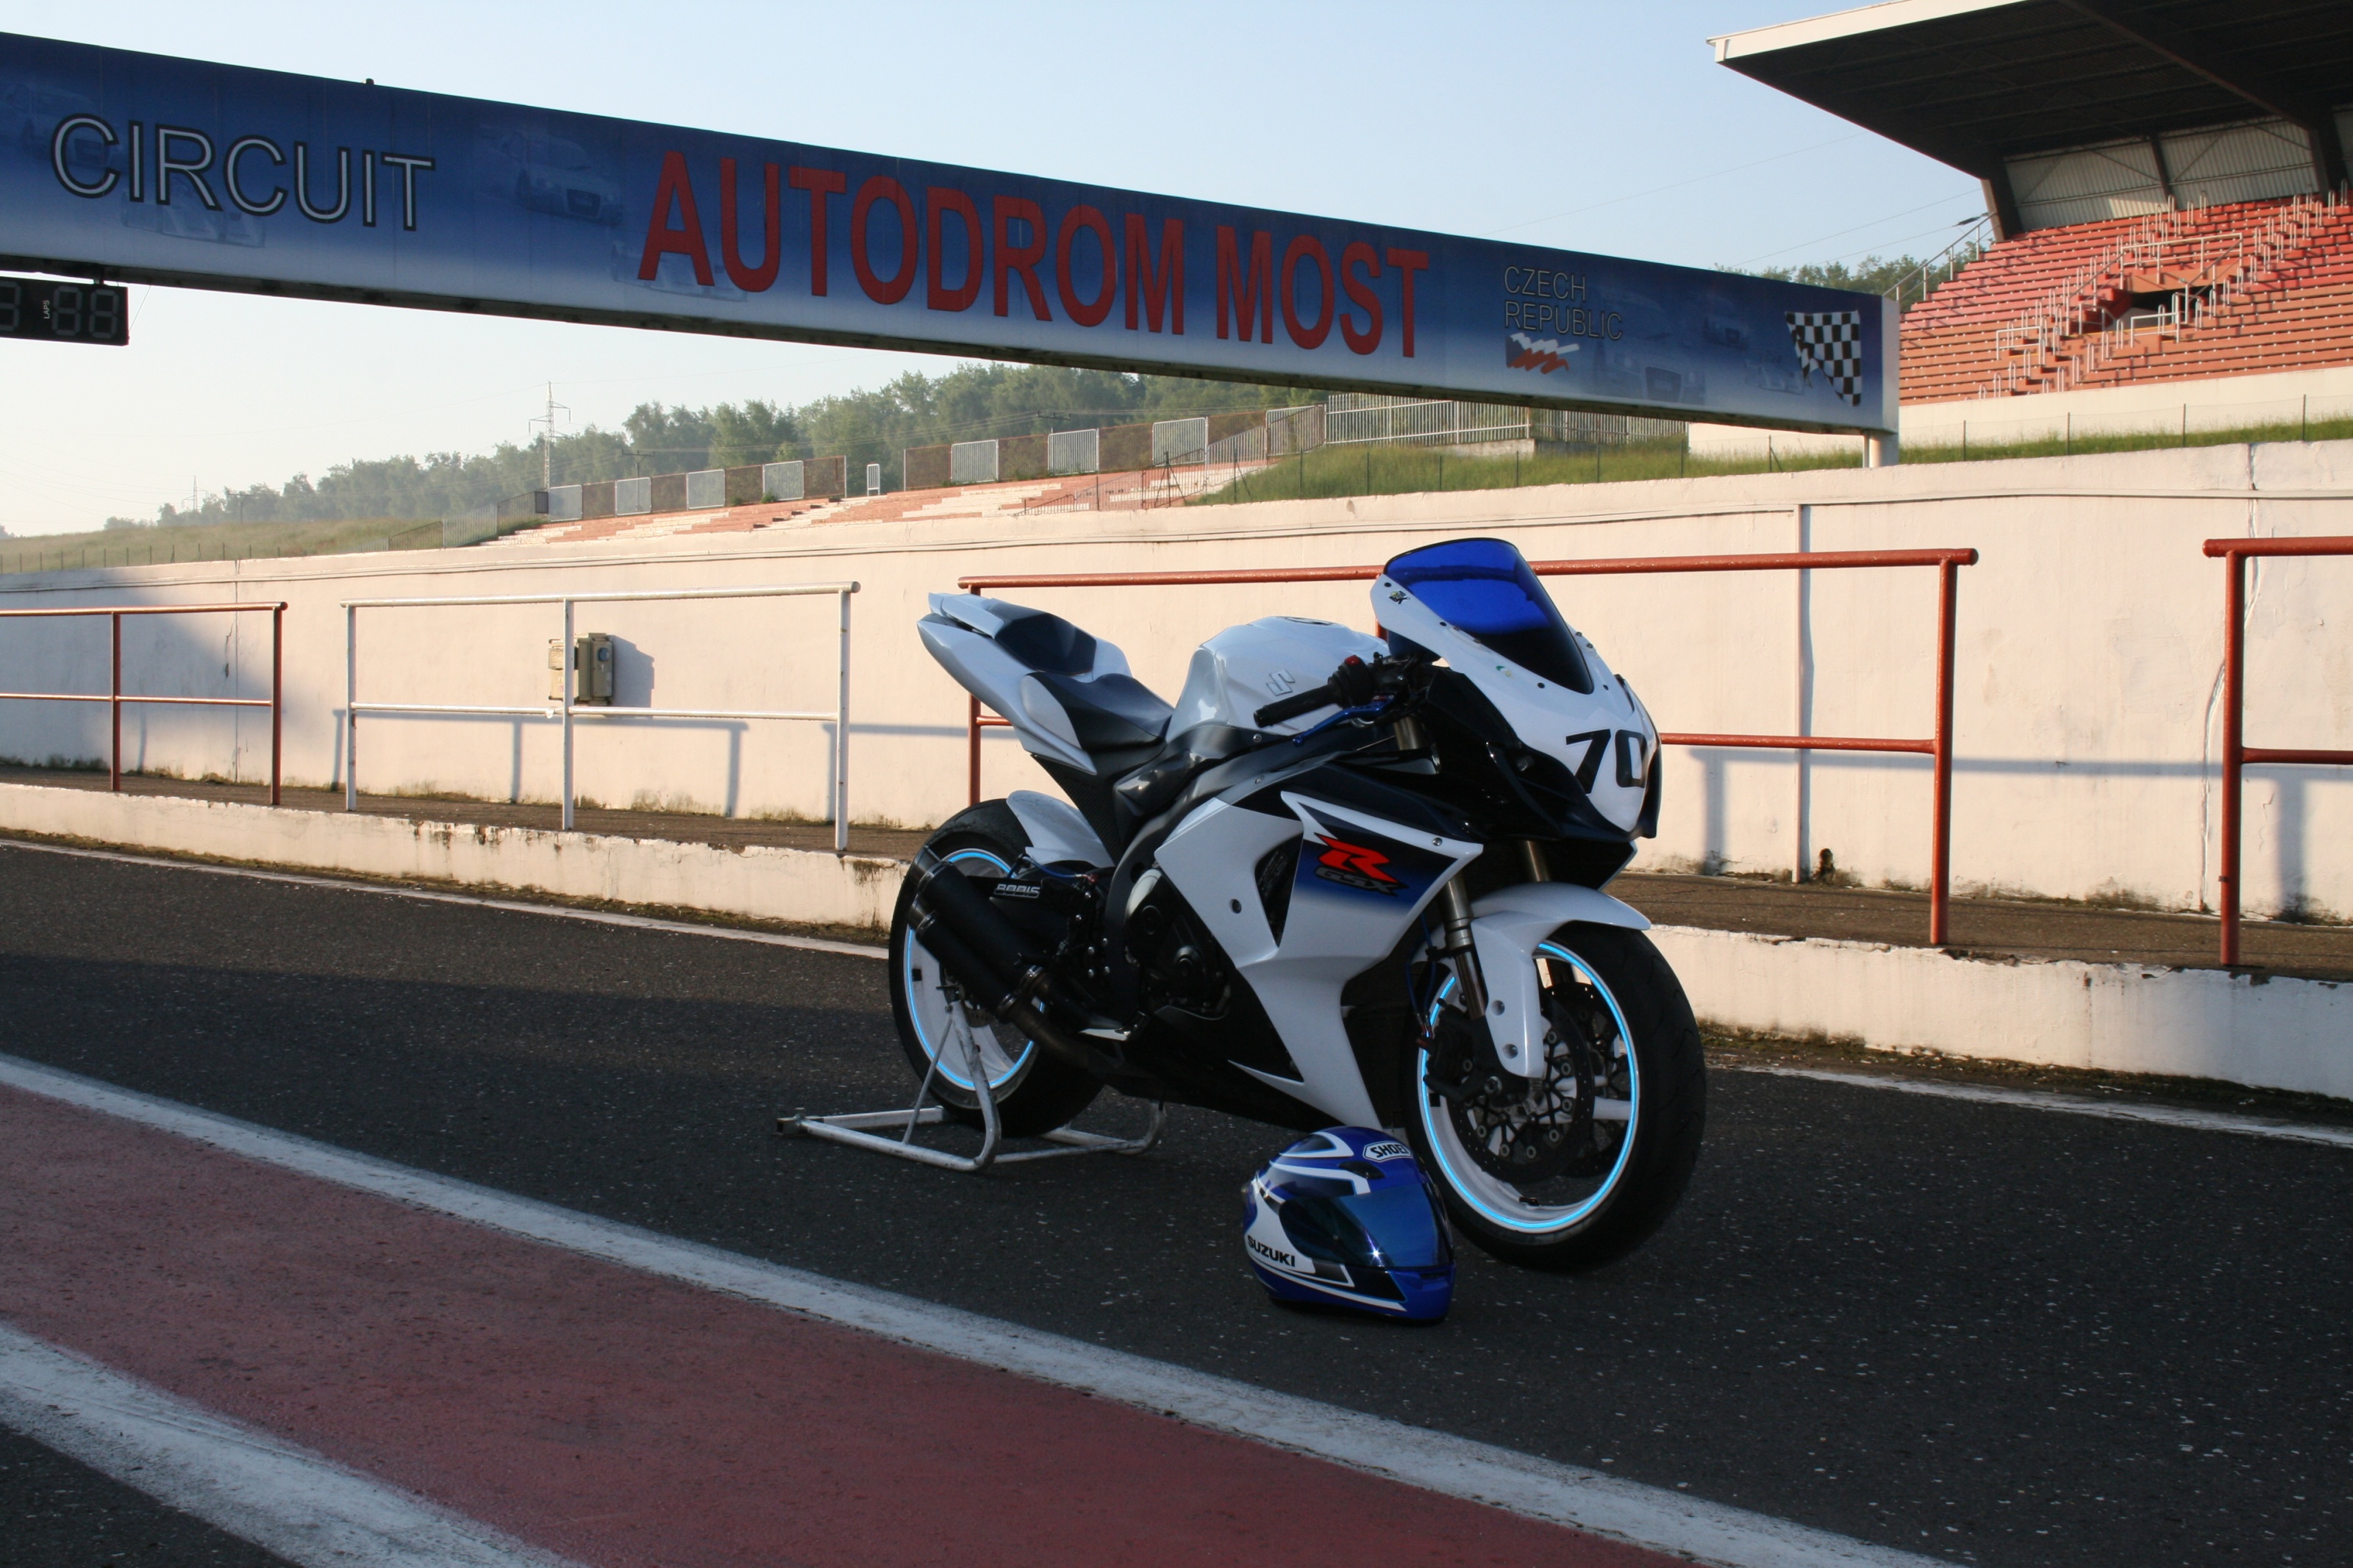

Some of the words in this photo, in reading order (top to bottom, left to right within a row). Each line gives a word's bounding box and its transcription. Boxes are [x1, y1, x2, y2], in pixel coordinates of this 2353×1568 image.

[51, 112, 436, 232] CIRCUIT
[638, 150, 1184, 335] AUTODROM
[1215, 224, 1429, 358] MOST
[1504, 265, 1586, 301] CZECH
[1504, 301, 1623, 340] REPUBLIC
[1565, 728, 1649, 795] 70
[993, 883, 1040, 898] BODIS
[1314, 865, 1399, 896] GSX
[1370, 1144, 1410, 1158] SHOEI
[1247, 1234, 1296, 1267] SUZUKI
